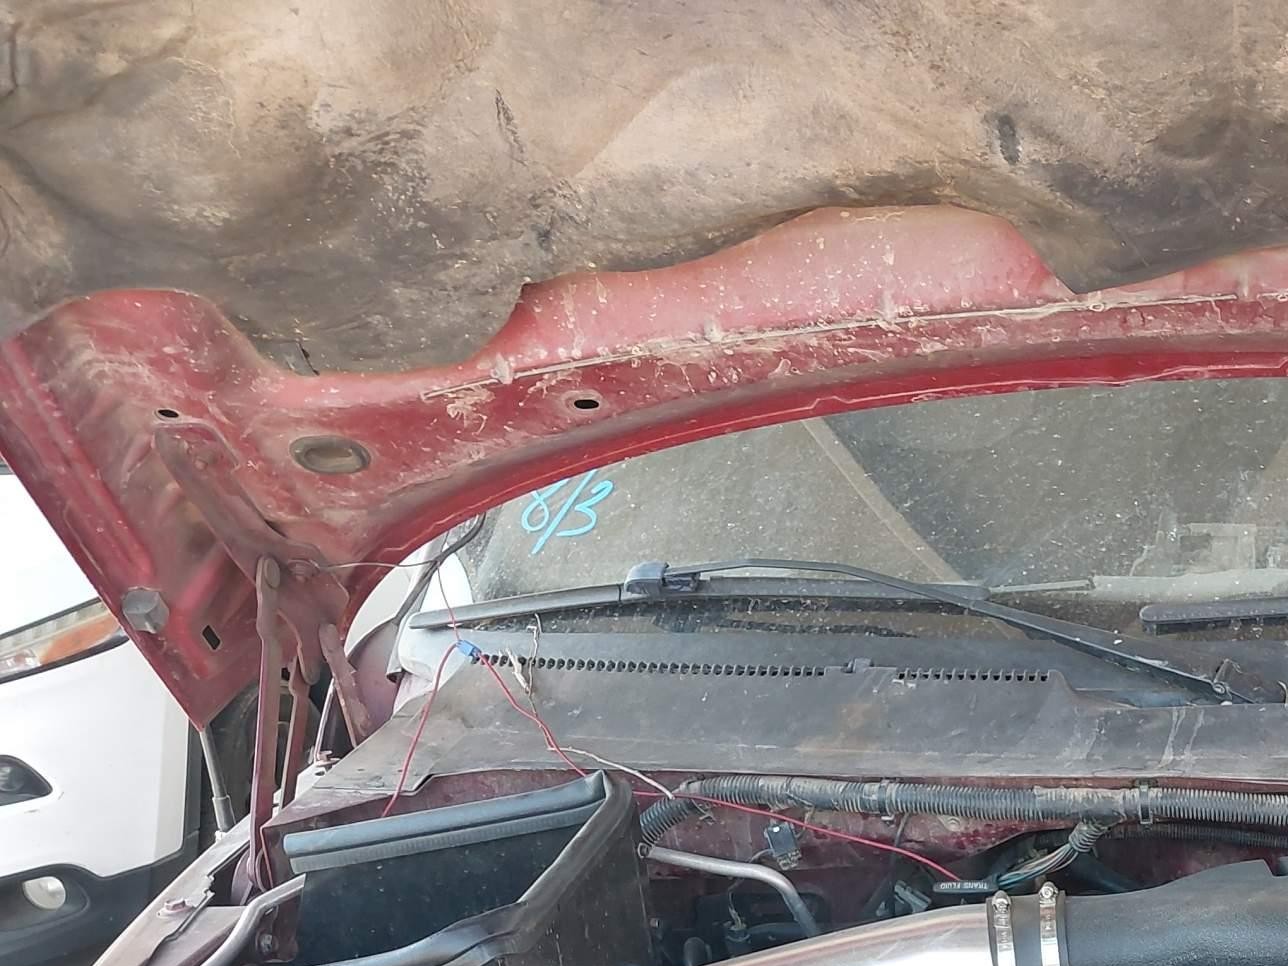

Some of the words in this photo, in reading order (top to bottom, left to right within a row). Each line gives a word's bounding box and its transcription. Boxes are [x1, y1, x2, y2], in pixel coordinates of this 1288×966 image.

[521, 469, 614, 555] 8/3
[940, 881, 961, 889] FLUID
[963, 880, 989, 889] TRANS
